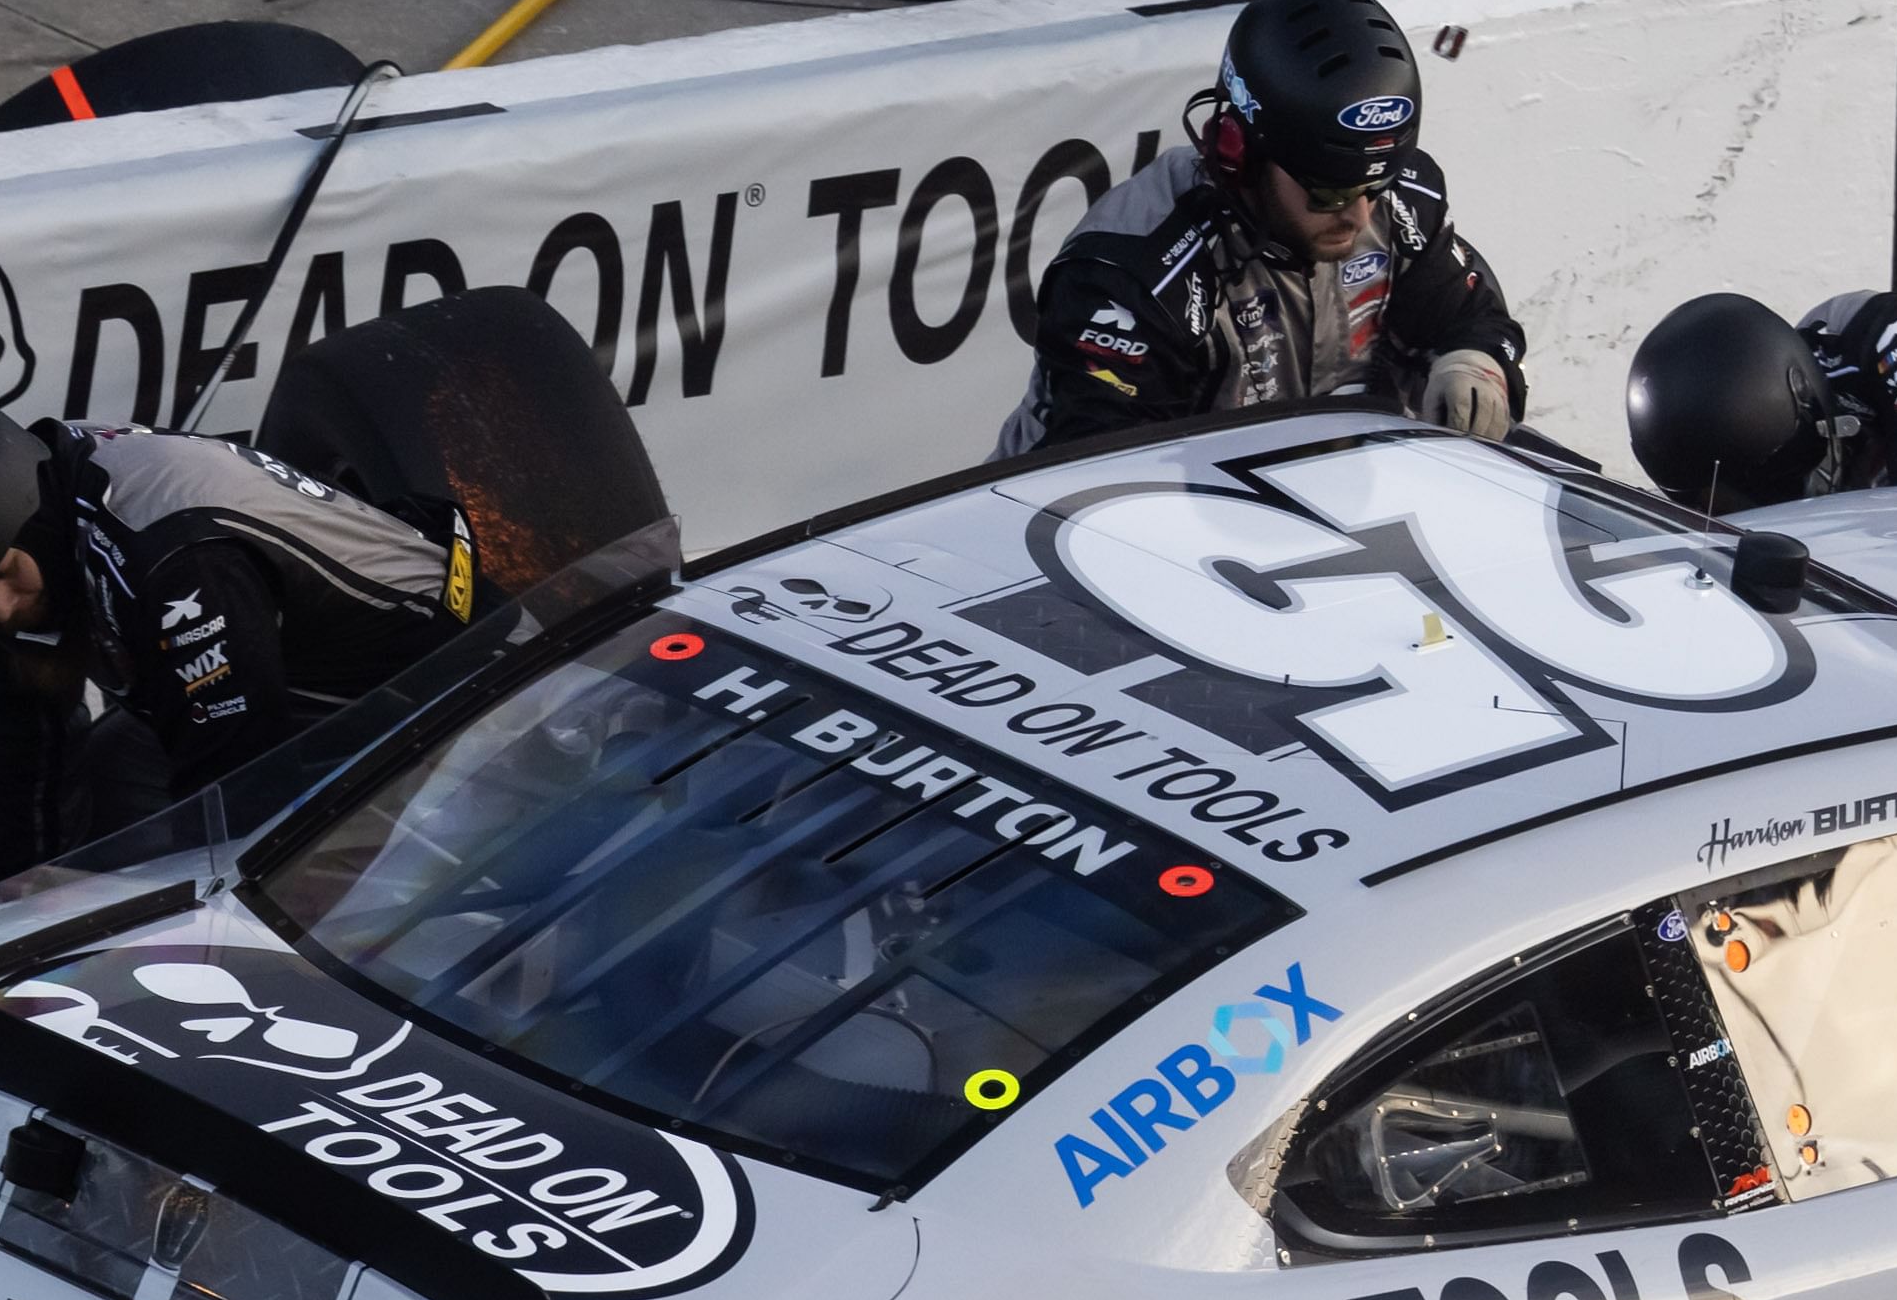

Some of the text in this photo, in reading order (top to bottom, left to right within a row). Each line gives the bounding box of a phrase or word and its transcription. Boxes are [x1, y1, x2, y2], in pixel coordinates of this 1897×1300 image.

[1354, 98, 1404, 127] Ford
[1366, 162, 1386, 177] 25
[1344, 256, 1379, 284] Ford
[527, 192, 739, 408] ON
[1079, 330, 1149, 357] FORD
[175, 614, 226, 645] NASCAR
[1027, 431, 1816, 812] 25
[175, 643, 229, 684] WIX
[207, 695, 246, 712] FLYING
[209, 704, 247, 719] CIRCLE
[827, 621, 1352, 865] DEAD ON TOOLS
[693, 667, 1135, 878] H. BURTON
[1697, 817, 1806, 875] Harrison
[1689, 1038, 1733, 1070] AIRBOX
[1052, 963, 1343, 1208] AIRBOX
[338, 1072, 665, 1235] DEAD ON
[260, 1102, 568, 1263] TOOLS
